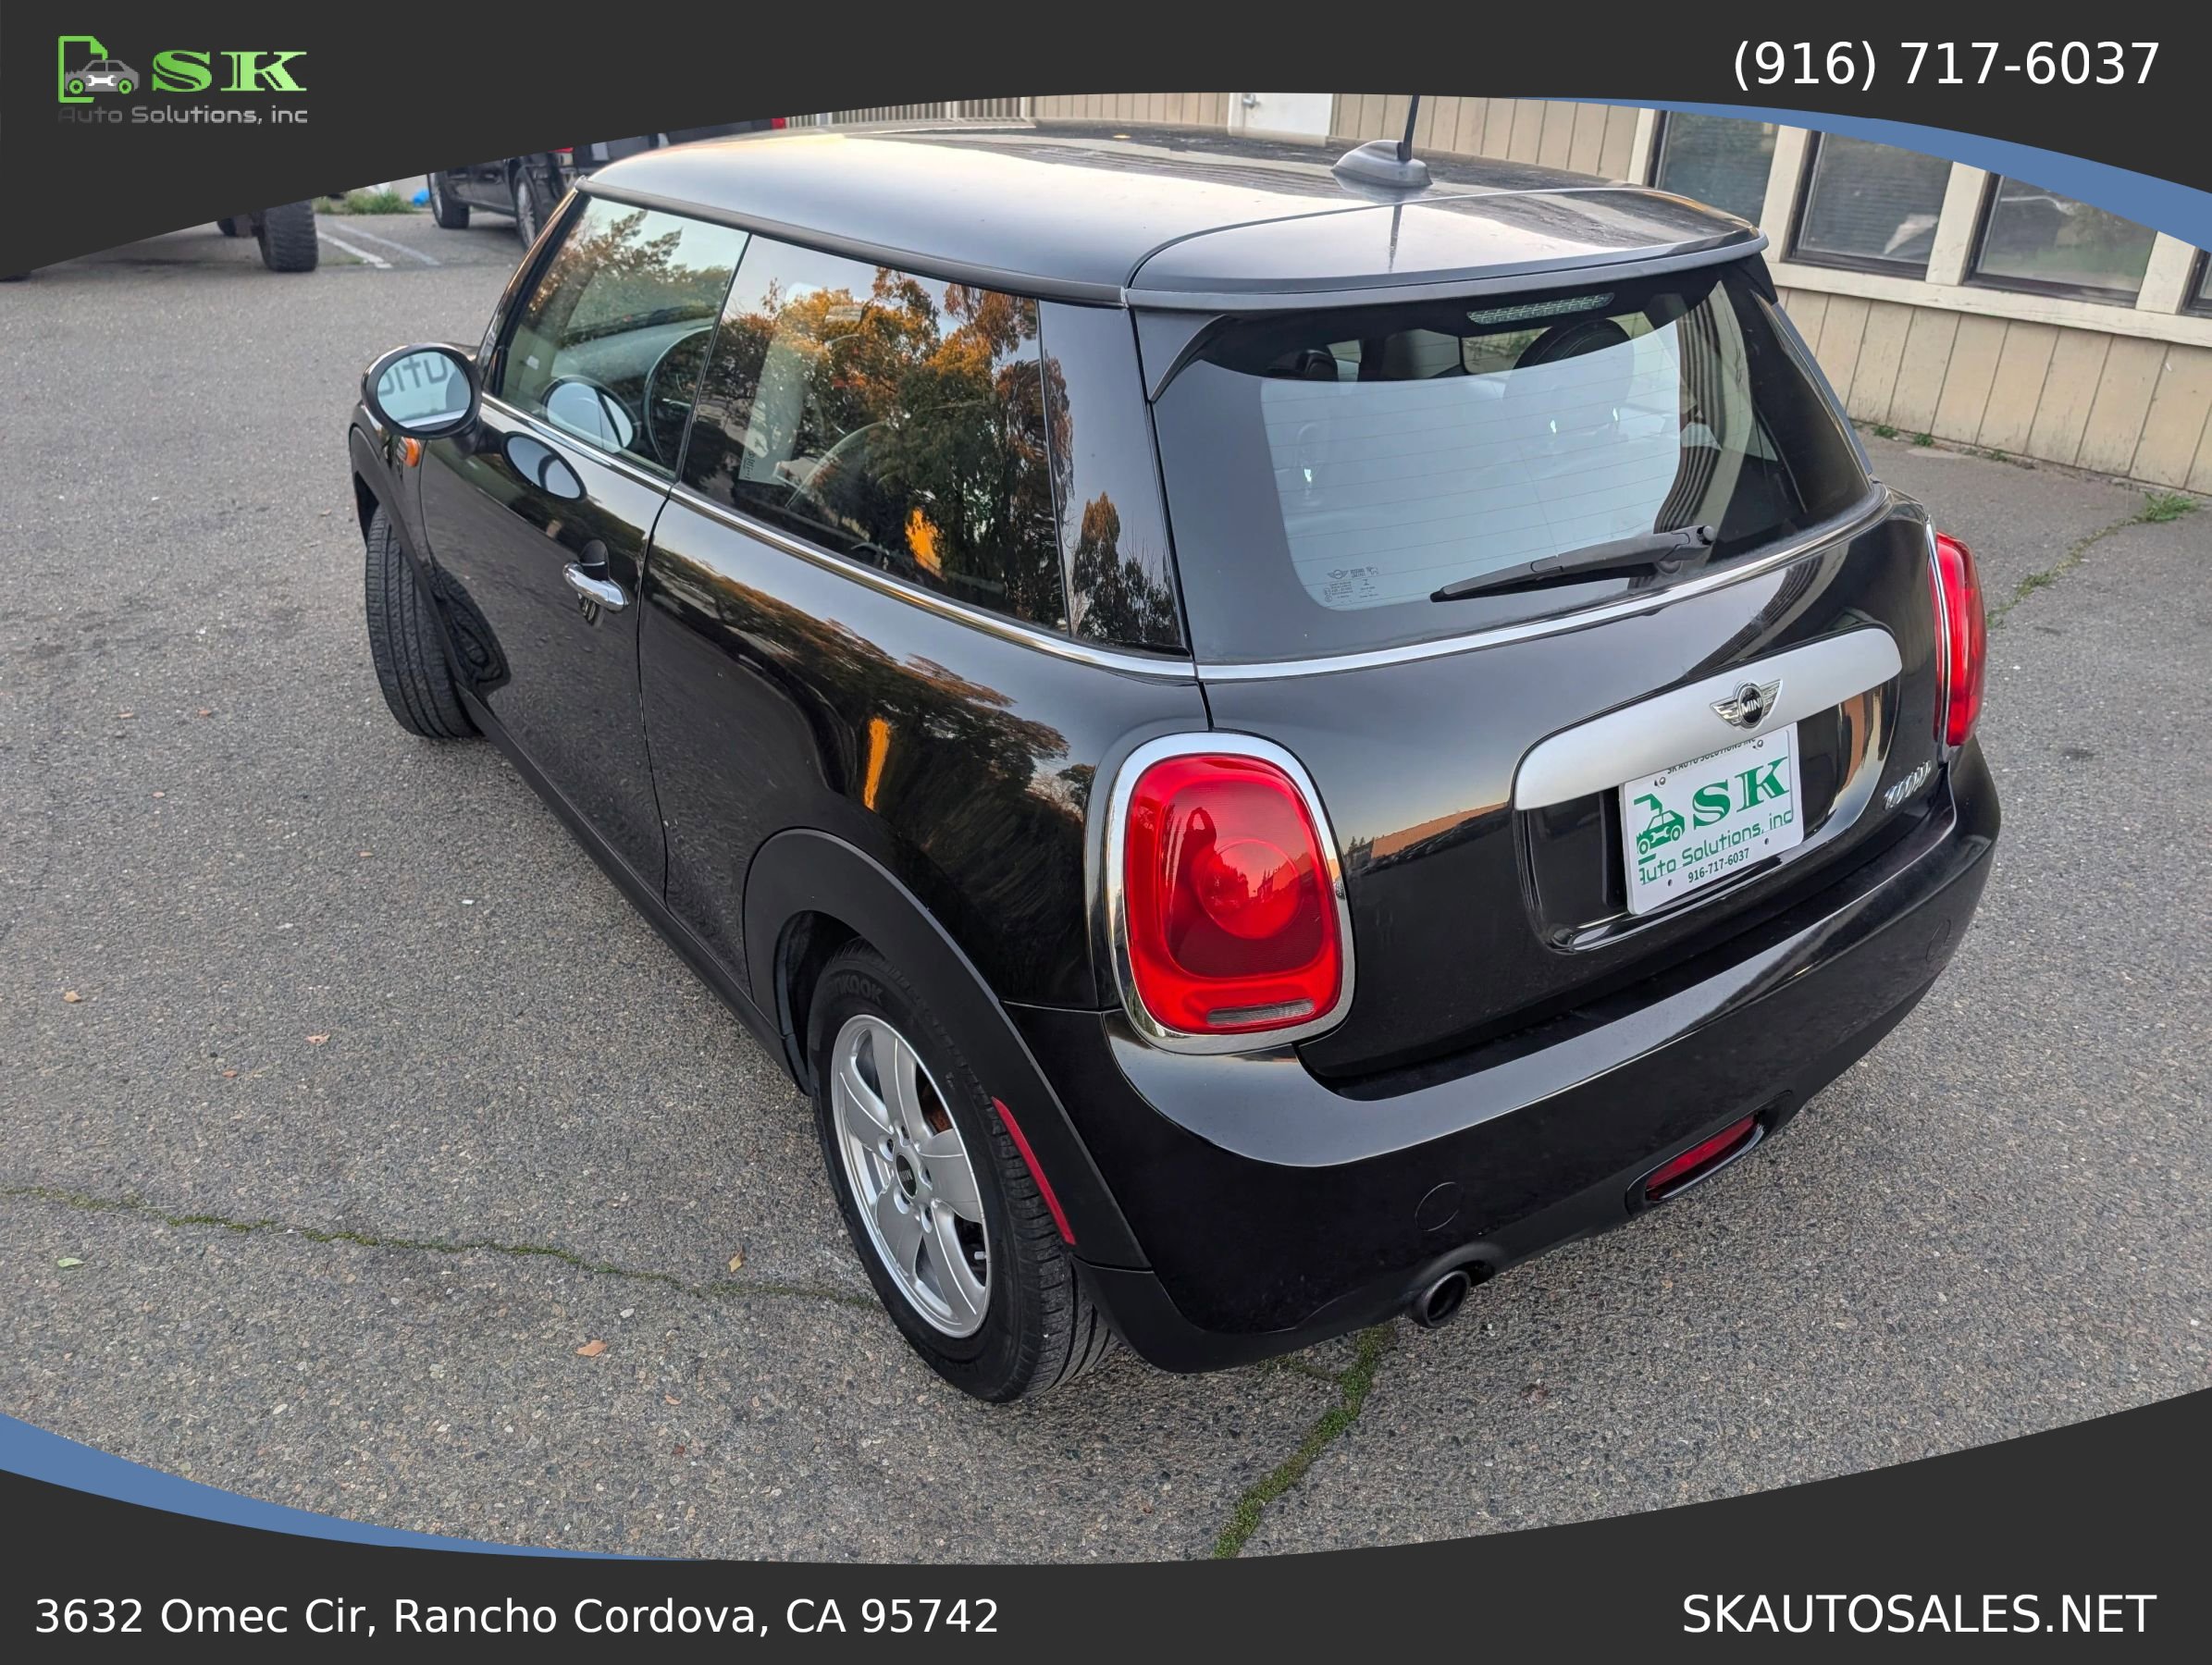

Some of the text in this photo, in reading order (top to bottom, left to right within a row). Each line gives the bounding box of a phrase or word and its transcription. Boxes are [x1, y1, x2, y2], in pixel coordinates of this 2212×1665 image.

[1740, 697, 1762, 716] MINI
[1692, 756, 1790, 830] SK
[1682, 821, 1764, 868] Solutions,
[1687, 847, 1749, 883] 916-717-6037
